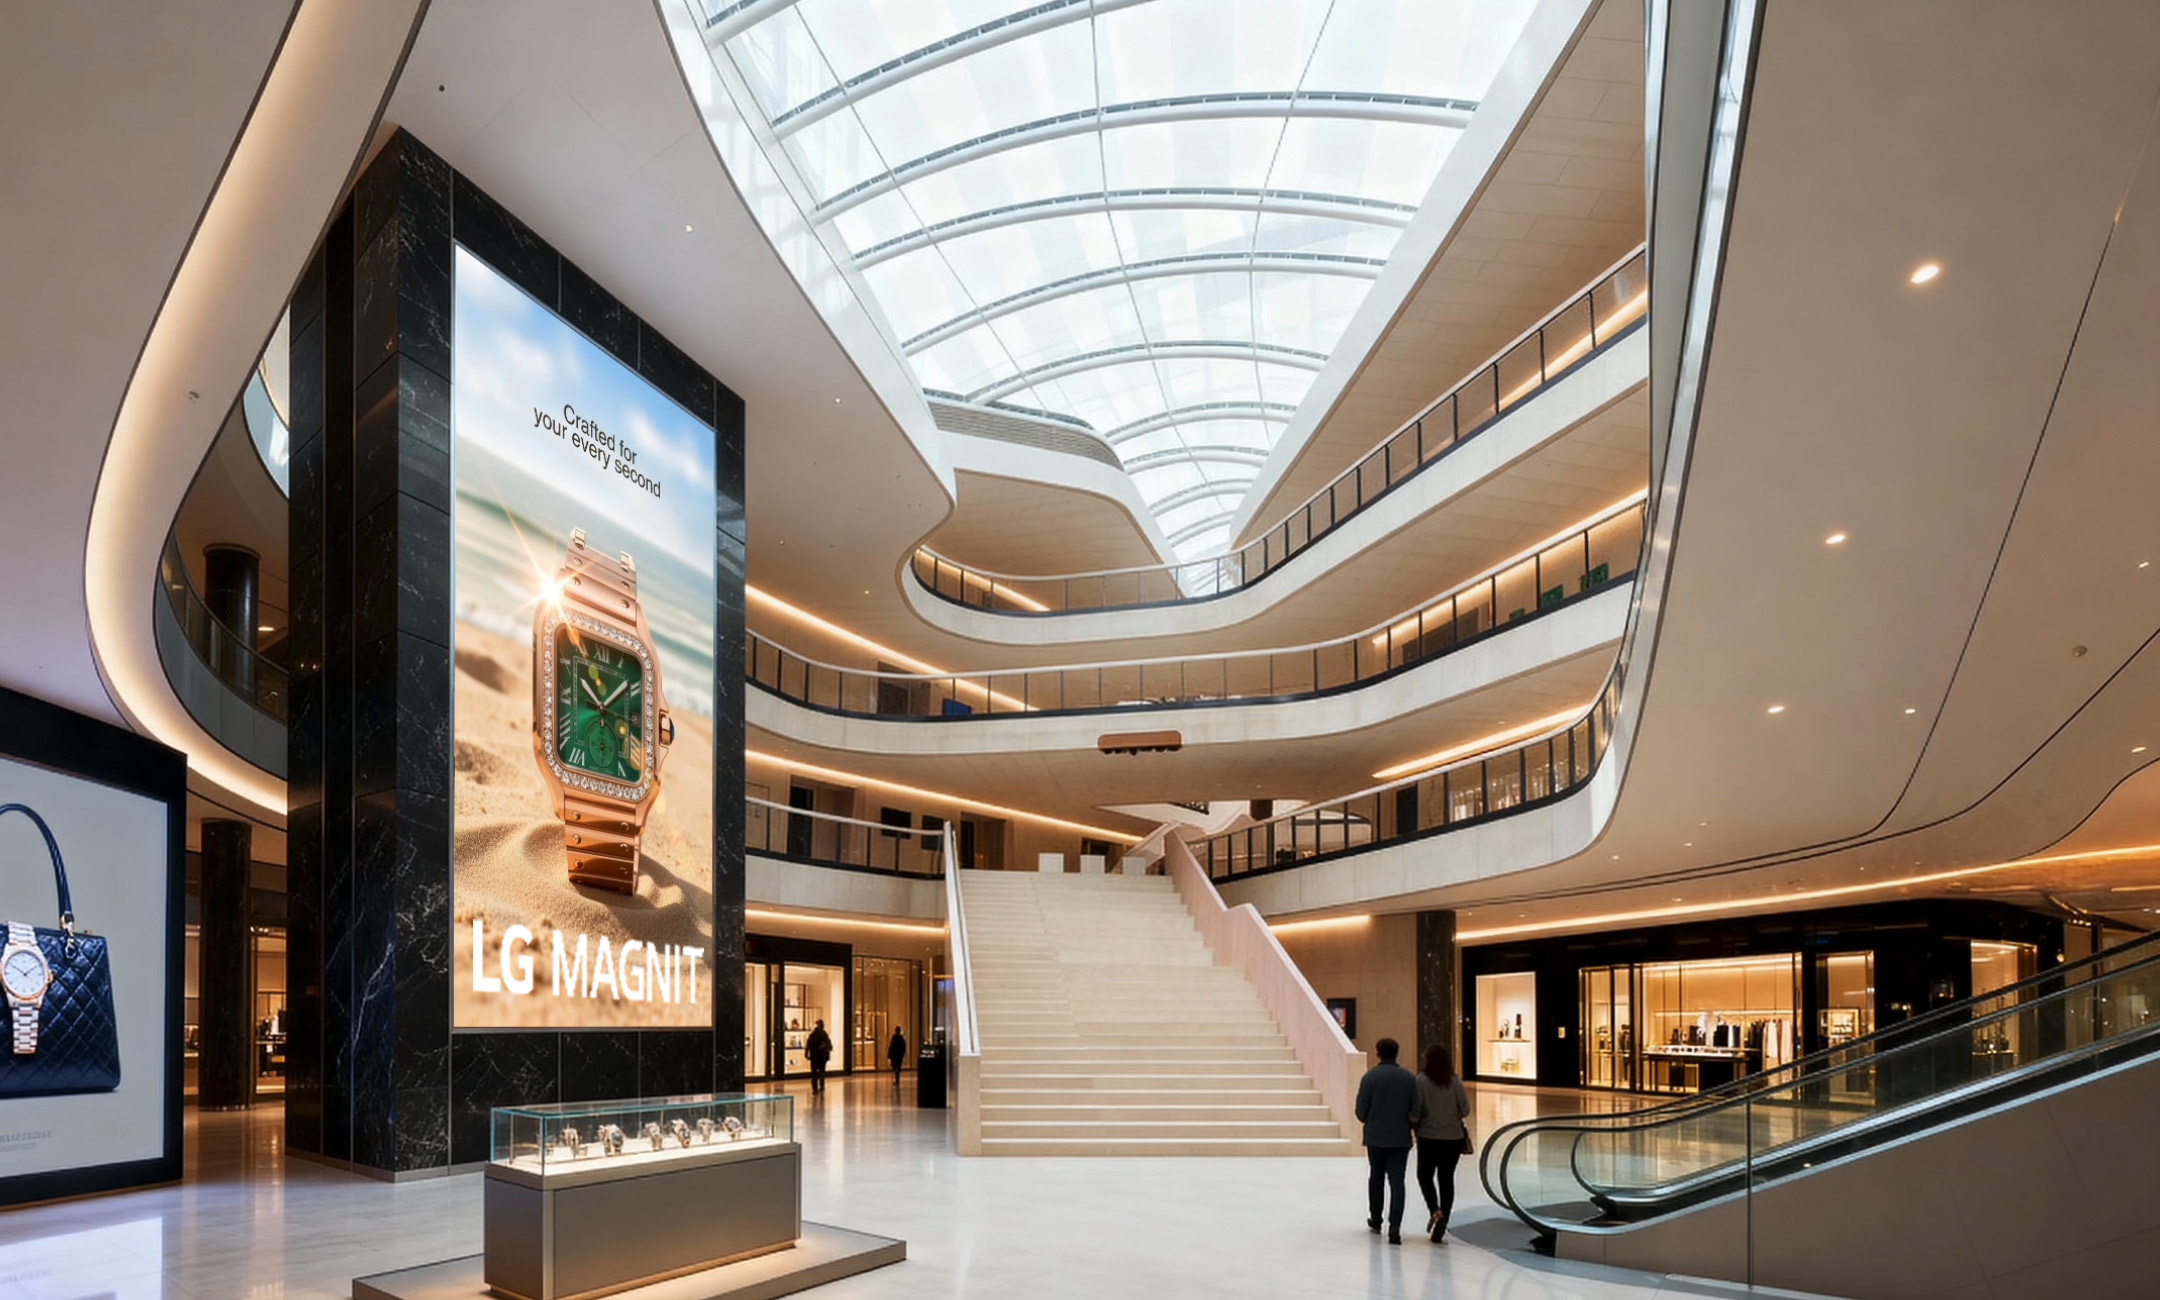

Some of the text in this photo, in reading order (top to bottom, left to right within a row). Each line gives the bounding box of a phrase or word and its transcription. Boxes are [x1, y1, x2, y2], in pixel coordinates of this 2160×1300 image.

[533, 407, 661, 498] your every second
[563, 404, 637, 464] Crafted for
[472, 918, 705, 1005] LG MAGNIT
